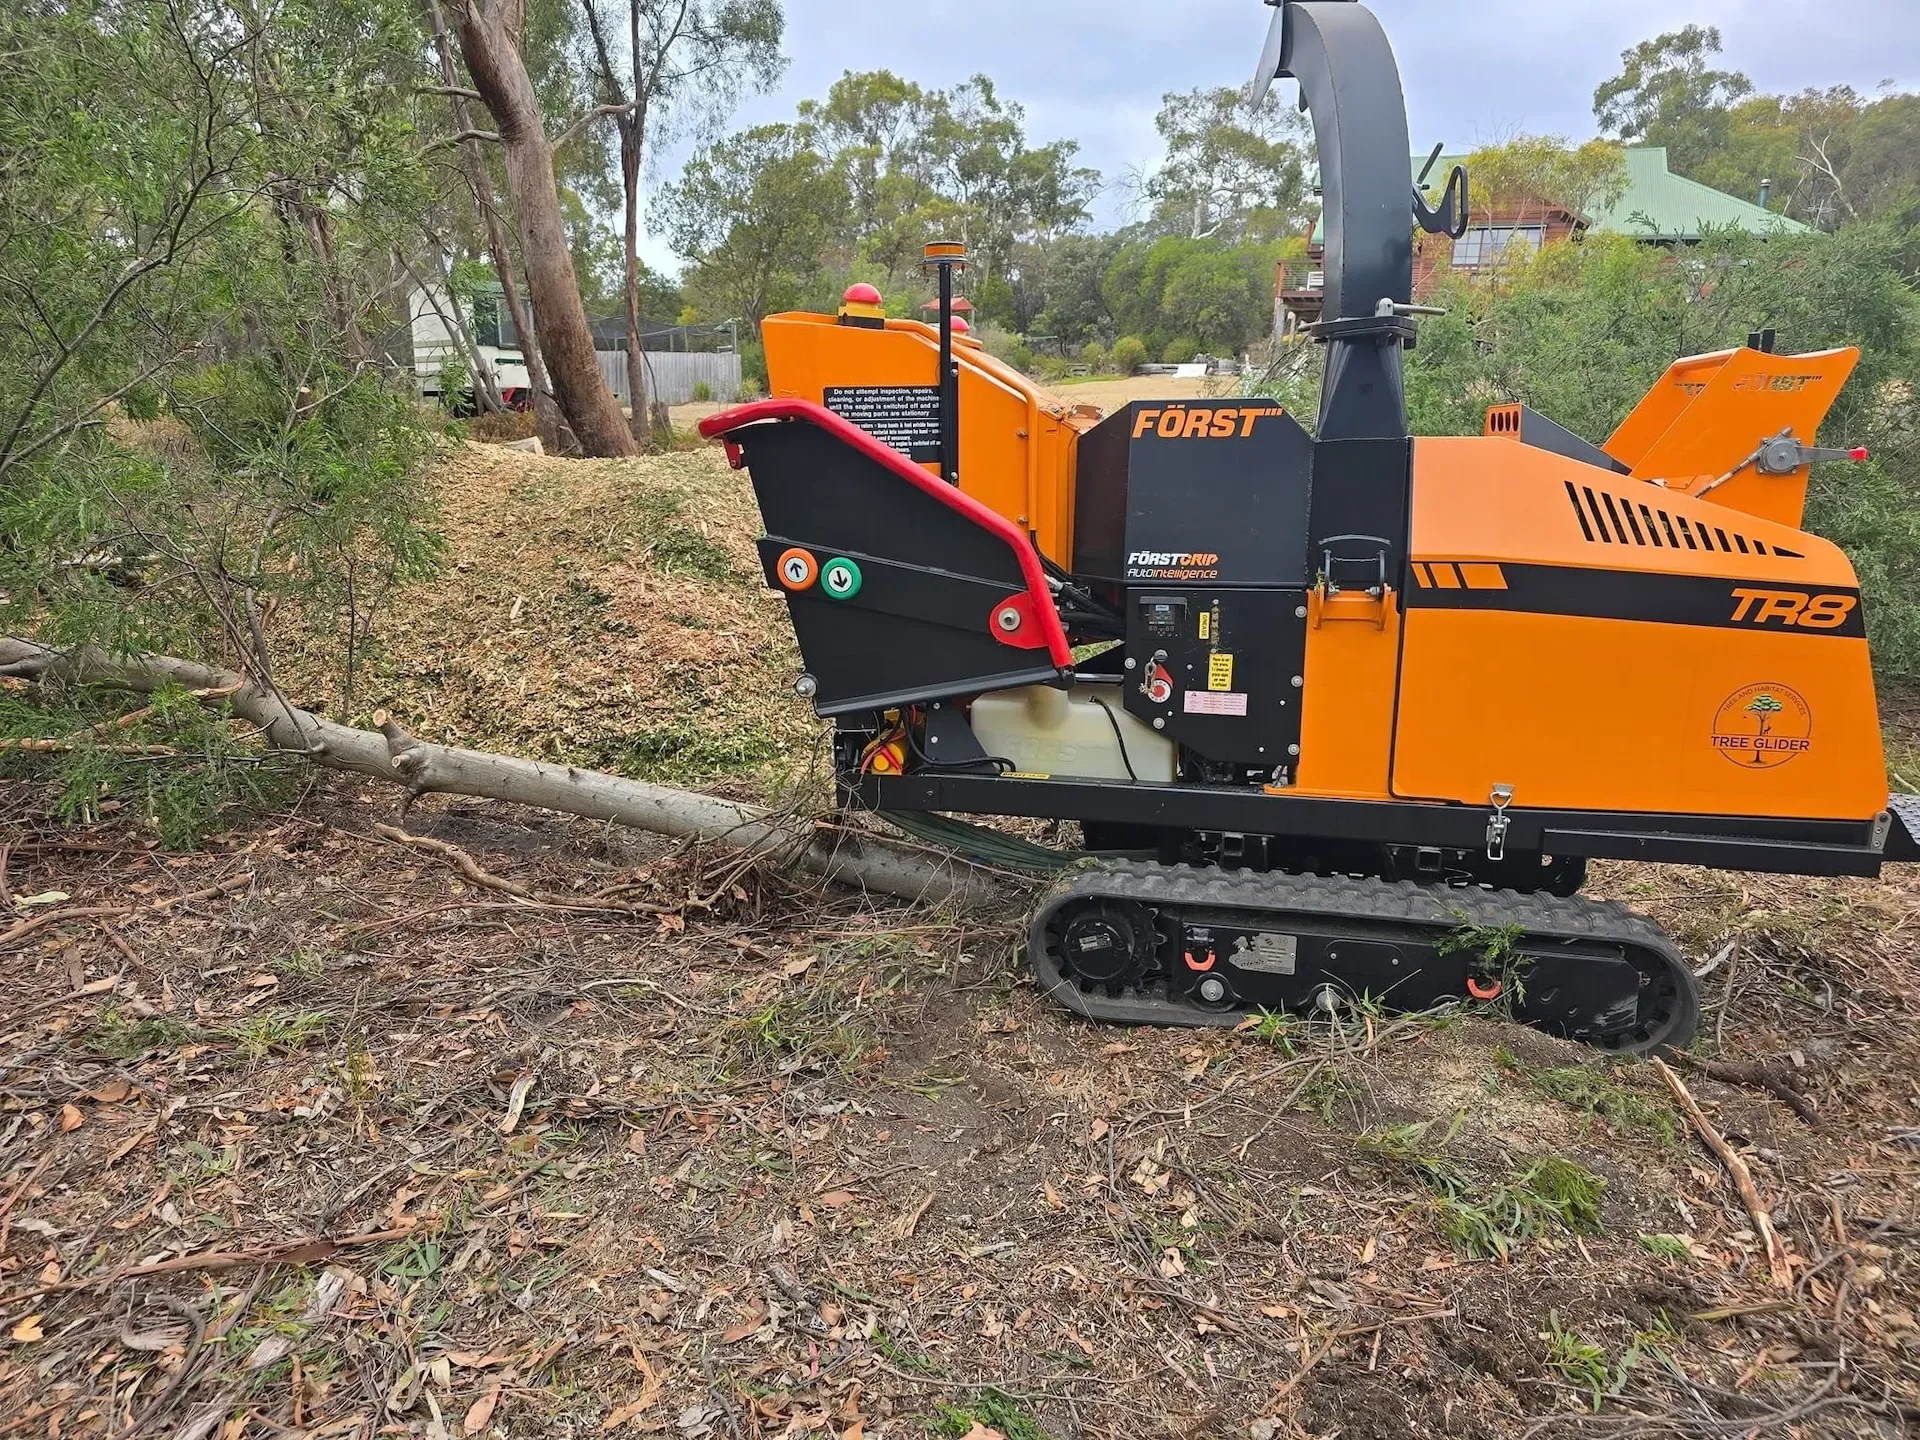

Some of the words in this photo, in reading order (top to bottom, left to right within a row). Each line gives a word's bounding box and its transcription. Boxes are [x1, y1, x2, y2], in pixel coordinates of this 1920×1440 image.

[856, 388, 879, 396] attempt
[880, 387, 911, 396] inspection,
[863, 395, 896, 403] adjustment
[916, 394, 940, 402] machine
[854, 403, 874, 411] engine
[883, 402, 909, 410] switched
[850, 410, 872, 419] moving
[873, 410, 889, 418] parts
[901, 409, 930, 418] stationary
[1132, 404, 1283, 438] FÖRST
[1730, 587, 1857, 628] TR8
[1723, 698, 1738, 712] TREE
[1738, 688, 1753, 699] AND
[1754, 685, 1784, 693] HABITAT
[1784, 690, 1807, 716] SERVICES
[1711, 735, 1750, 748] TREE
[1753, 737, 1810, 751] GLIDER
